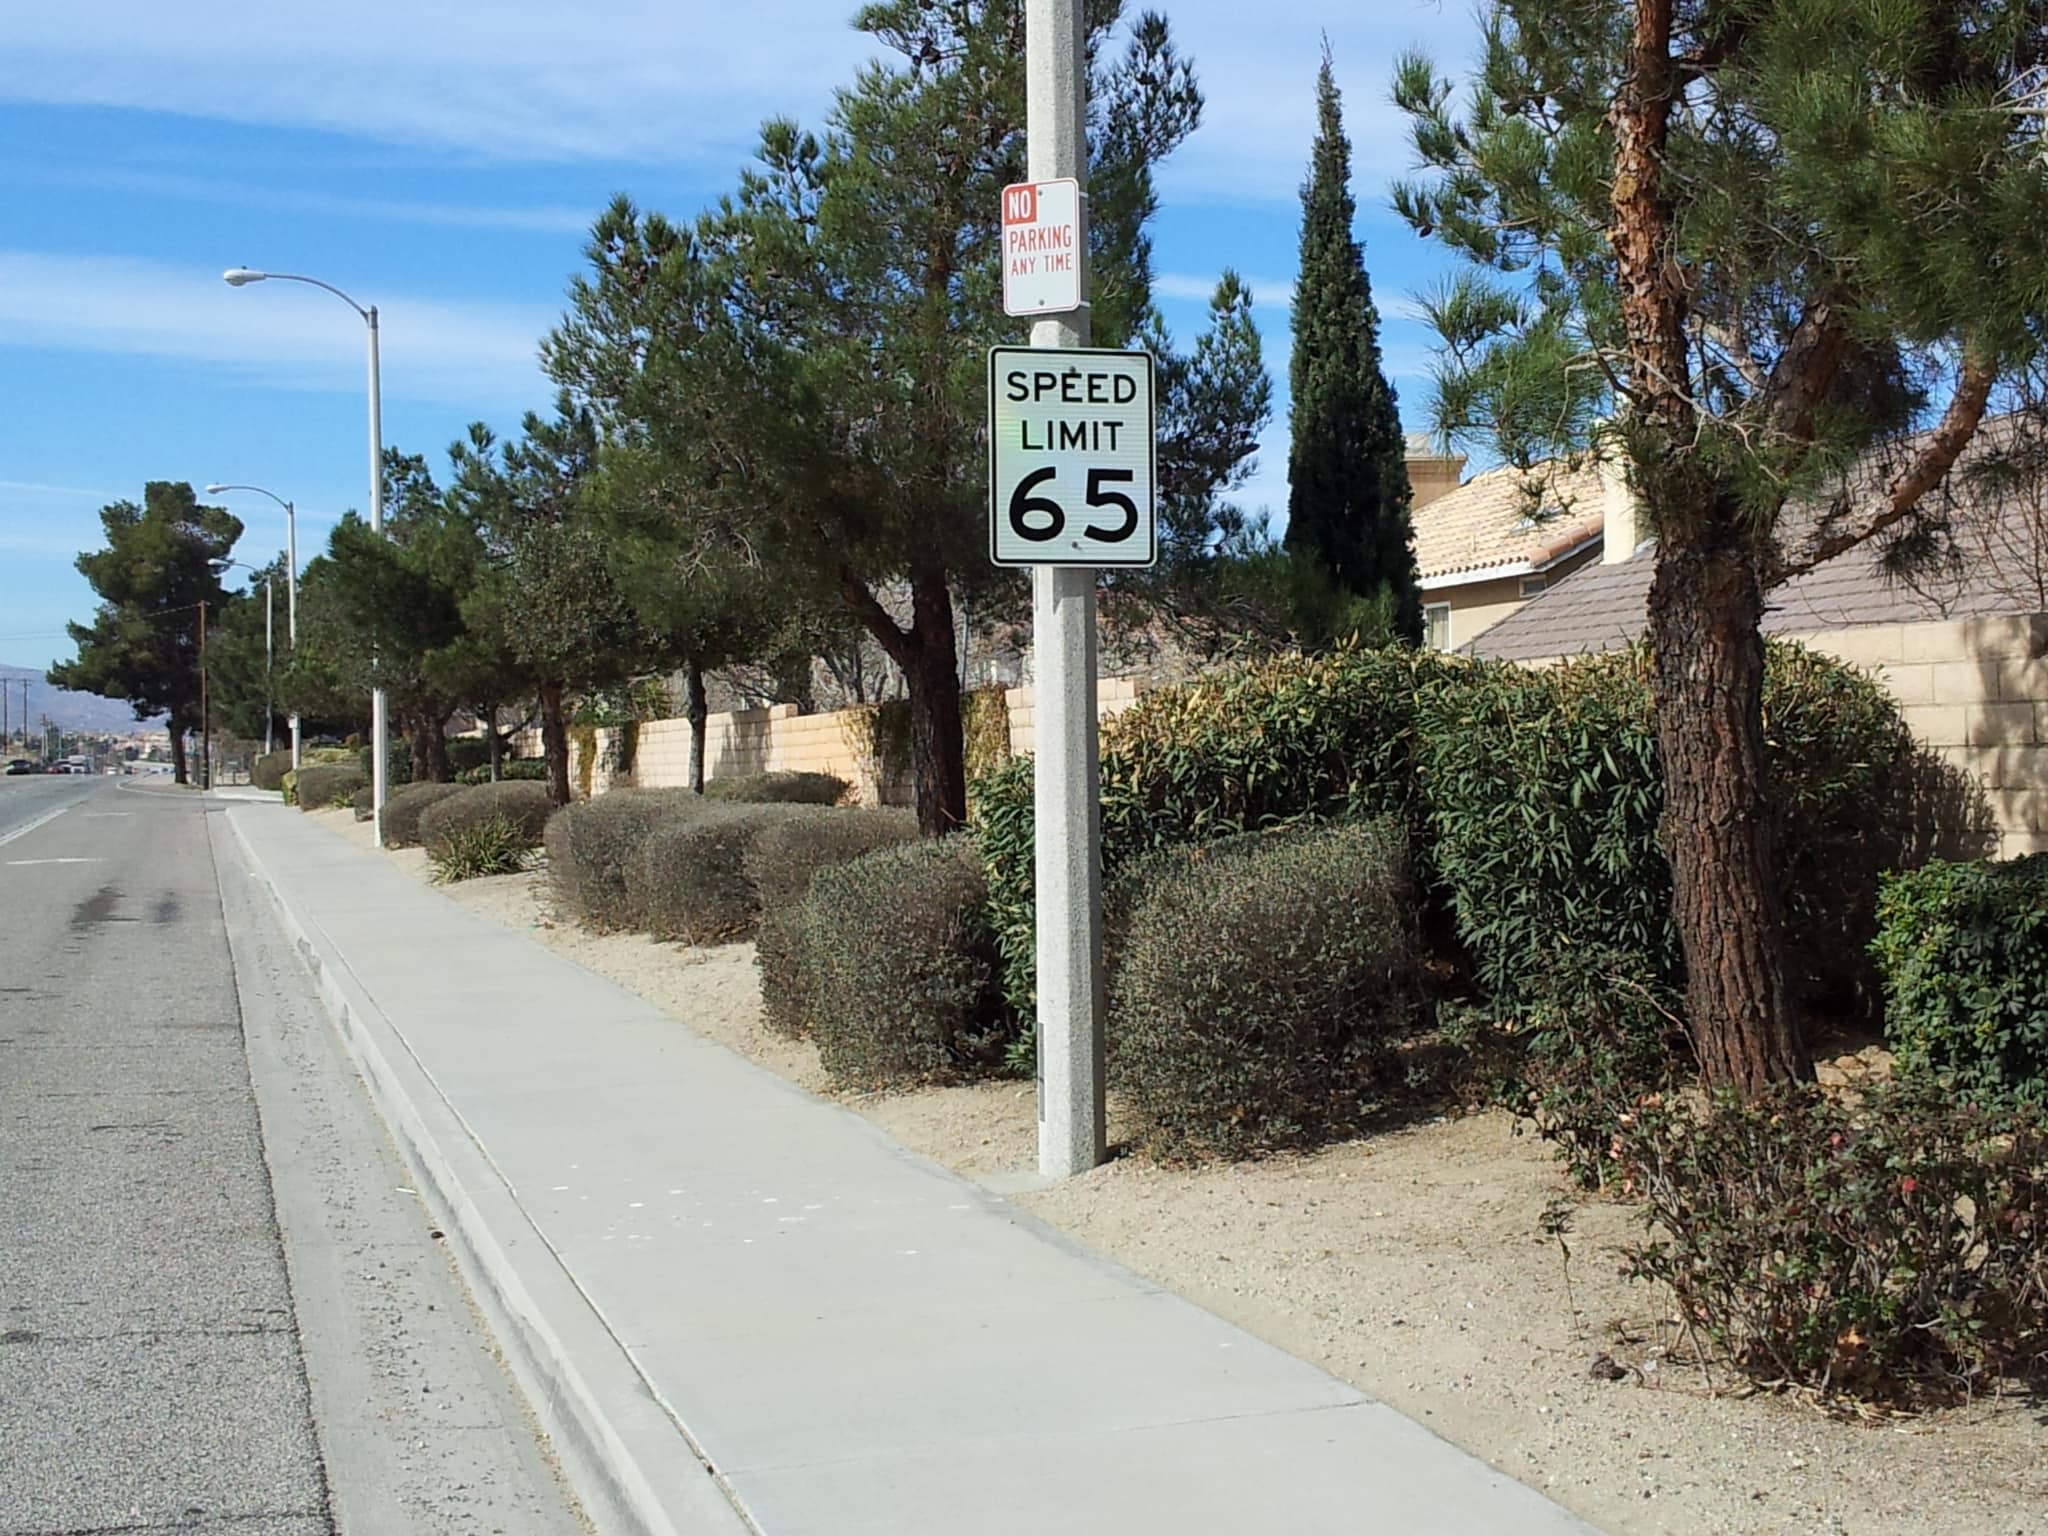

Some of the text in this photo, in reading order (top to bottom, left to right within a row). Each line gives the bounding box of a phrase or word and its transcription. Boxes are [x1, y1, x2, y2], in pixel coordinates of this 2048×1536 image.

[1008, 190, 1032, 221] NO
[1009, 224, 1072, 254] PARKING
[1011, 251, 1072, 277] ANY TIME
[1006, 371, 1137, 404] SPEED
[1021, 420, 1124, 451] LIMIT
[1009, 466, 1139, 543] 65
